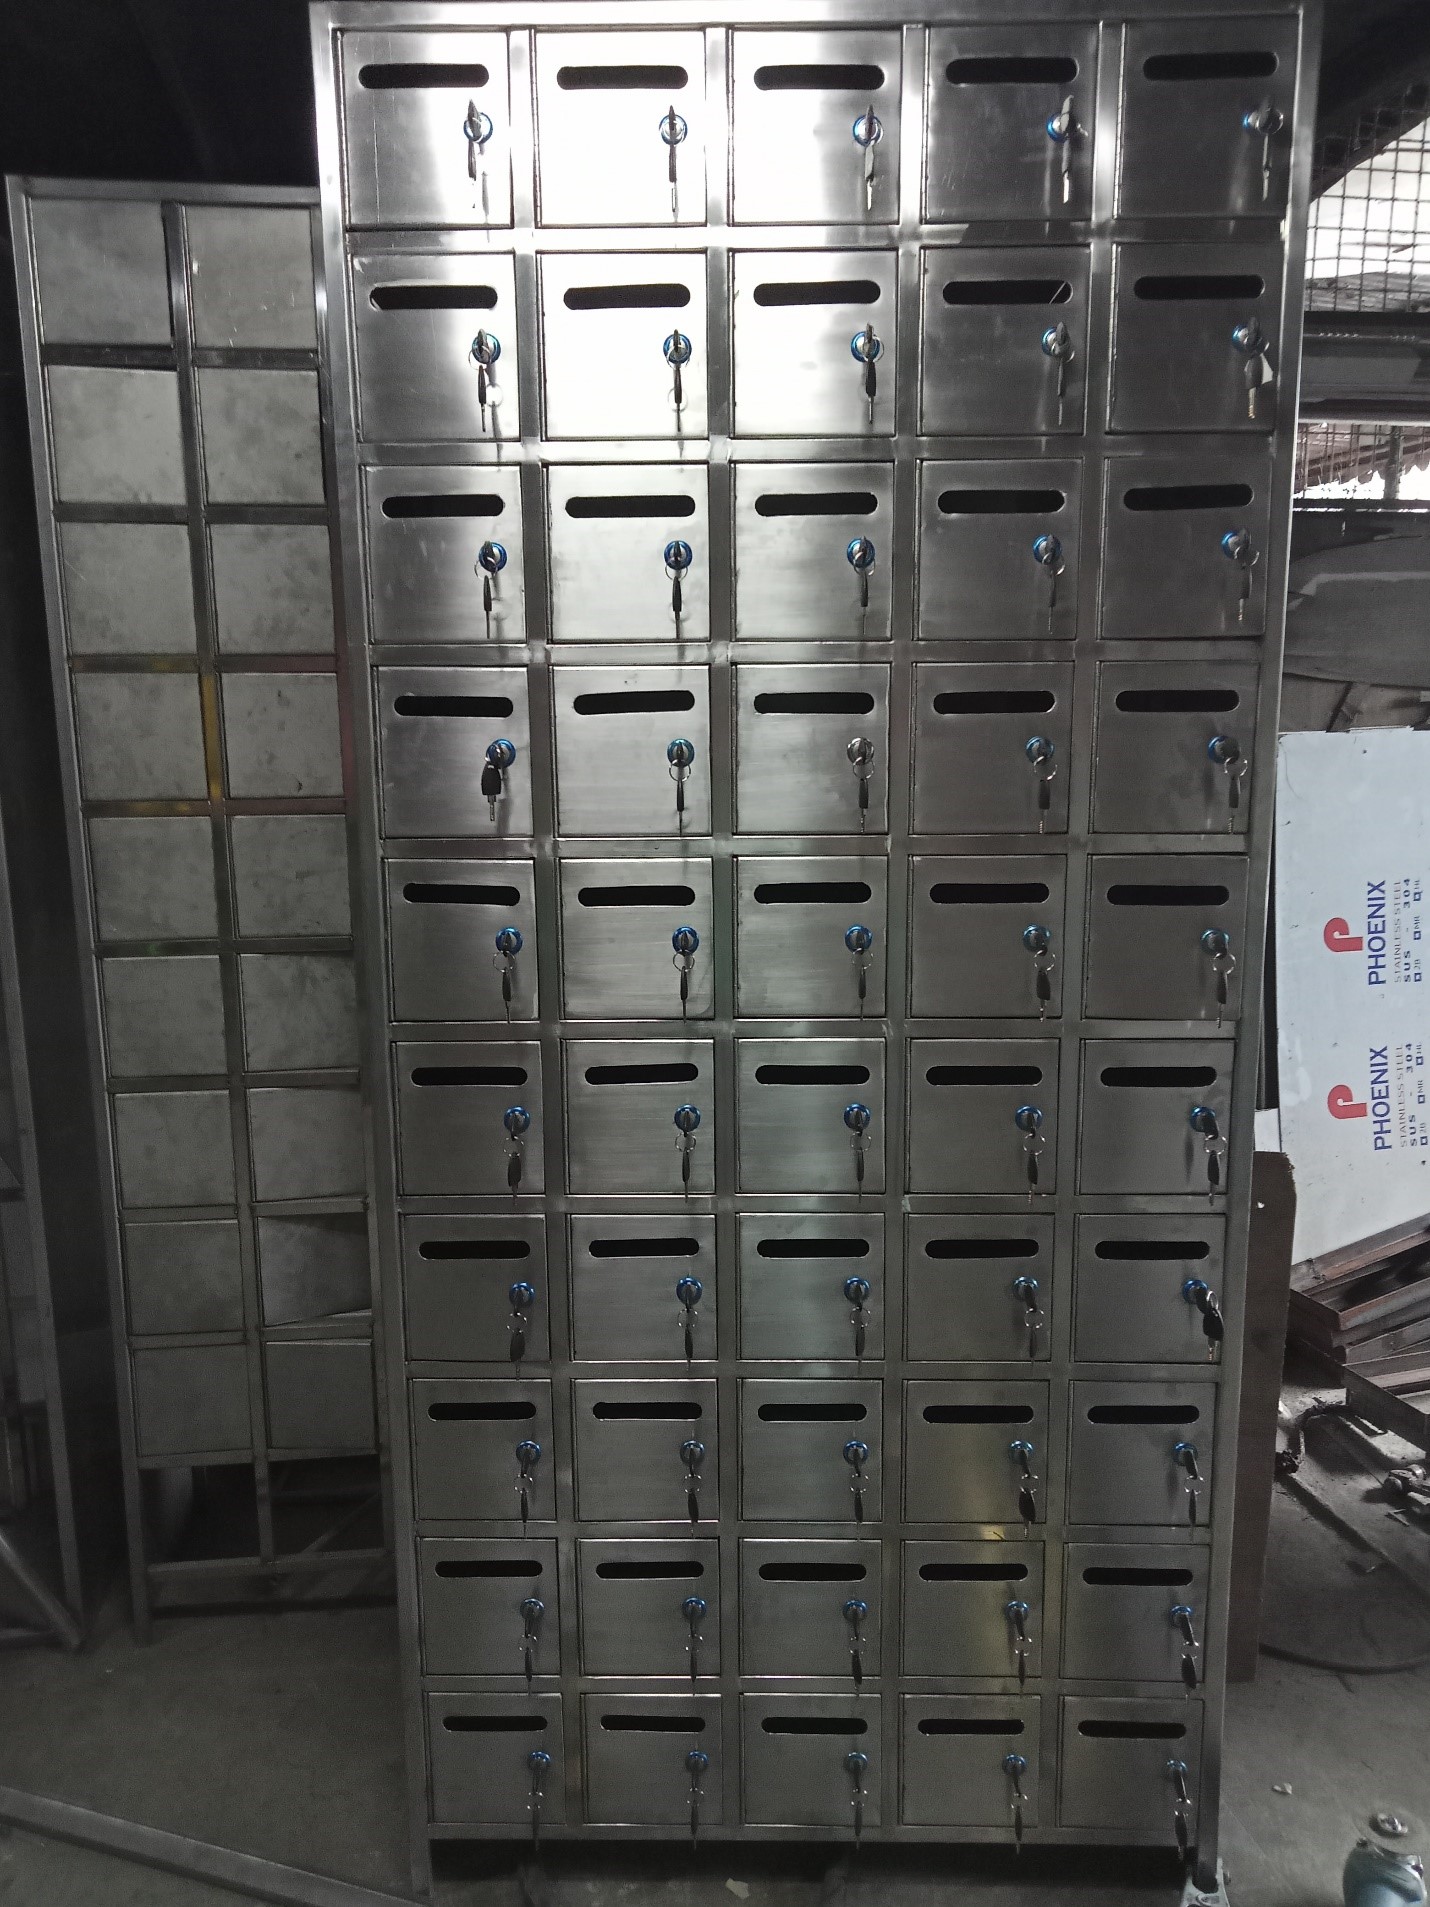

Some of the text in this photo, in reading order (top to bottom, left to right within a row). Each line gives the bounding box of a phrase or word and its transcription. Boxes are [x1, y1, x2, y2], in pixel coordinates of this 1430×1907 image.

[1393, 882, 1401, 914] STEEL
[1367, 880, 1386, 985] PHOENIX
[1405, 1043, 1413, 1073] 304
[1369, 1046, 1392, 1151] PHOENIX
[1396, 1047, 1407, 1147] STAINLESS STEEL
[1409, 1114, 1417, 1146] SUS
